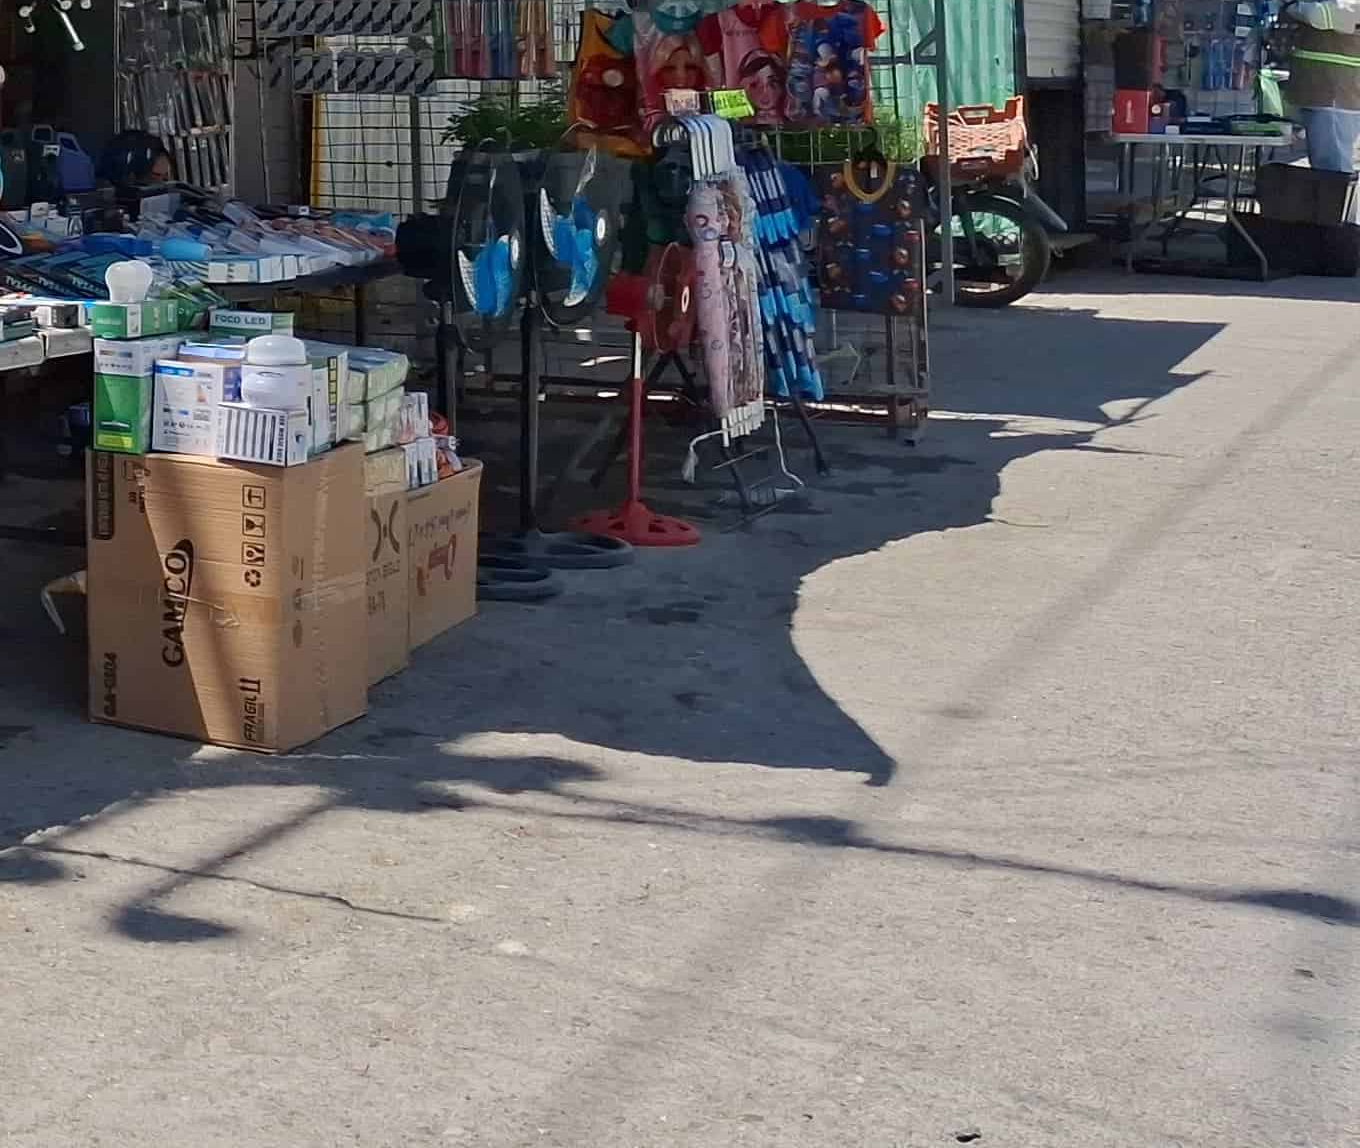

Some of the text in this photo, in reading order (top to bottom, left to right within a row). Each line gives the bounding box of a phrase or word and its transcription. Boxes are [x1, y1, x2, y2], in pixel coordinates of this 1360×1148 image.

[214, 314, 267, 326] FOCO LED
[161, 551, 187, 668] GAMCO
[241, 693, 257, 743] FRAGIL
